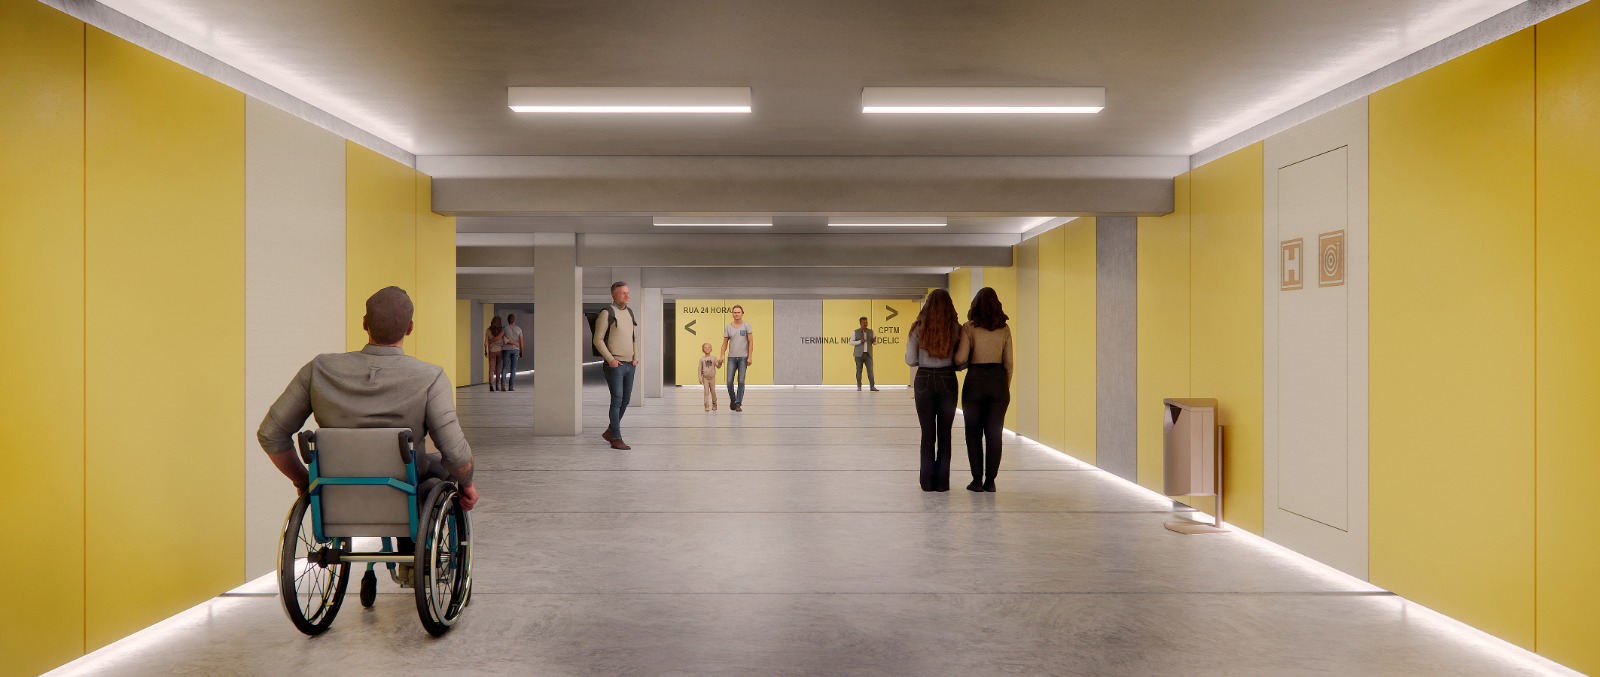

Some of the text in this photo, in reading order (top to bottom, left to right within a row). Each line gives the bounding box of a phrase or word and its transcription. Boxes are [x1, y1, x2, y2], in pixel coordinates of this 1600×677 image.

[683, 306, 733, 314] RUA 24 HORA
[878, 326, 900, 334] CPTM
[800, 336, 839, 344] TERMINAL
[877, 336, 900, 344] DELIC
